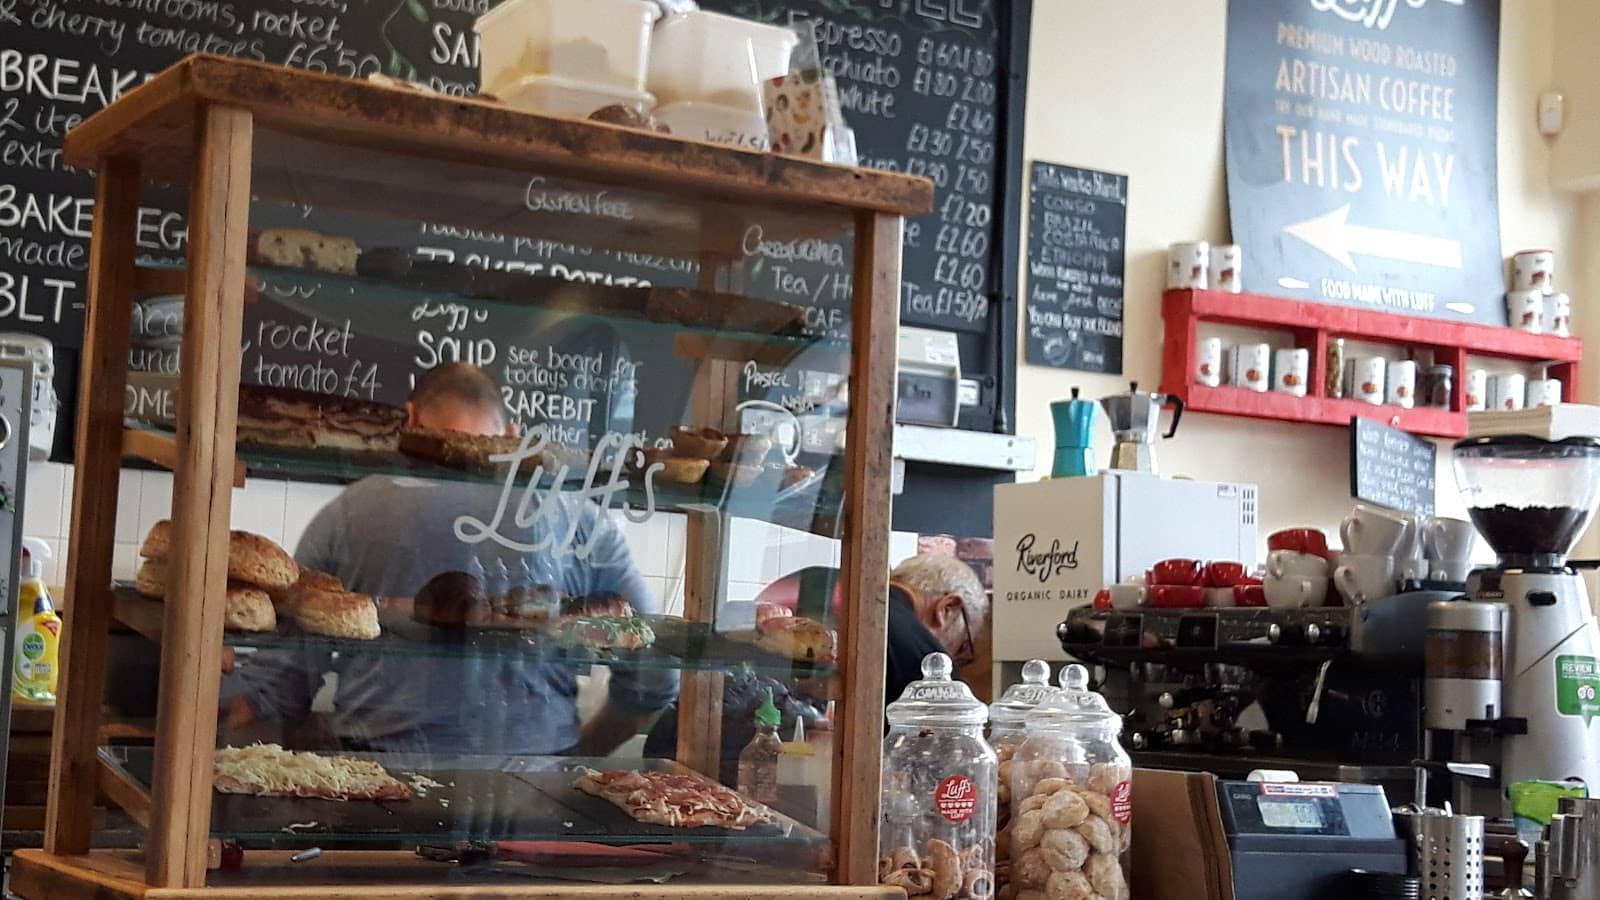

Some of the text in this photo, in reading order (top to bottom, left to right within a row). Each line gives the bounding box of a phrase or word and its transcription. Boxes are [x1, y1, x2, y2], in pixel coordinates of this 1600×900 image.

[32, 5, 126, 56] cherry
[1276, 22, 1457, 77] PREMIUM WOOD ROASTED
[1275, 57, 1372, 104] ARTISAN
[1379, 75, 1455, 122] COFFEE
[1275, 124, 1455, 209] THIS WAY
[771, 266, 810, 295] Tea
[1320, 278, 1352, 300] FOOD
[257, 317, 355, 358] rocket
[415, 329, 499, 369] SOUP
[254, 354, 383, 400] tomato £4
[503, 364, 569, 393] todays
[508, 345, 540, 366] see
[549, 344, 604, 375] board
[453, 423, 666, 560] Luff's
[1016, 533, 1080, 583] Riverford
[1006, 587, 1089, 602] ORGANIC DAIRY
[1561, 662, 1593, 673] REVIEW
[941, 778, 971, 799] Luff's
